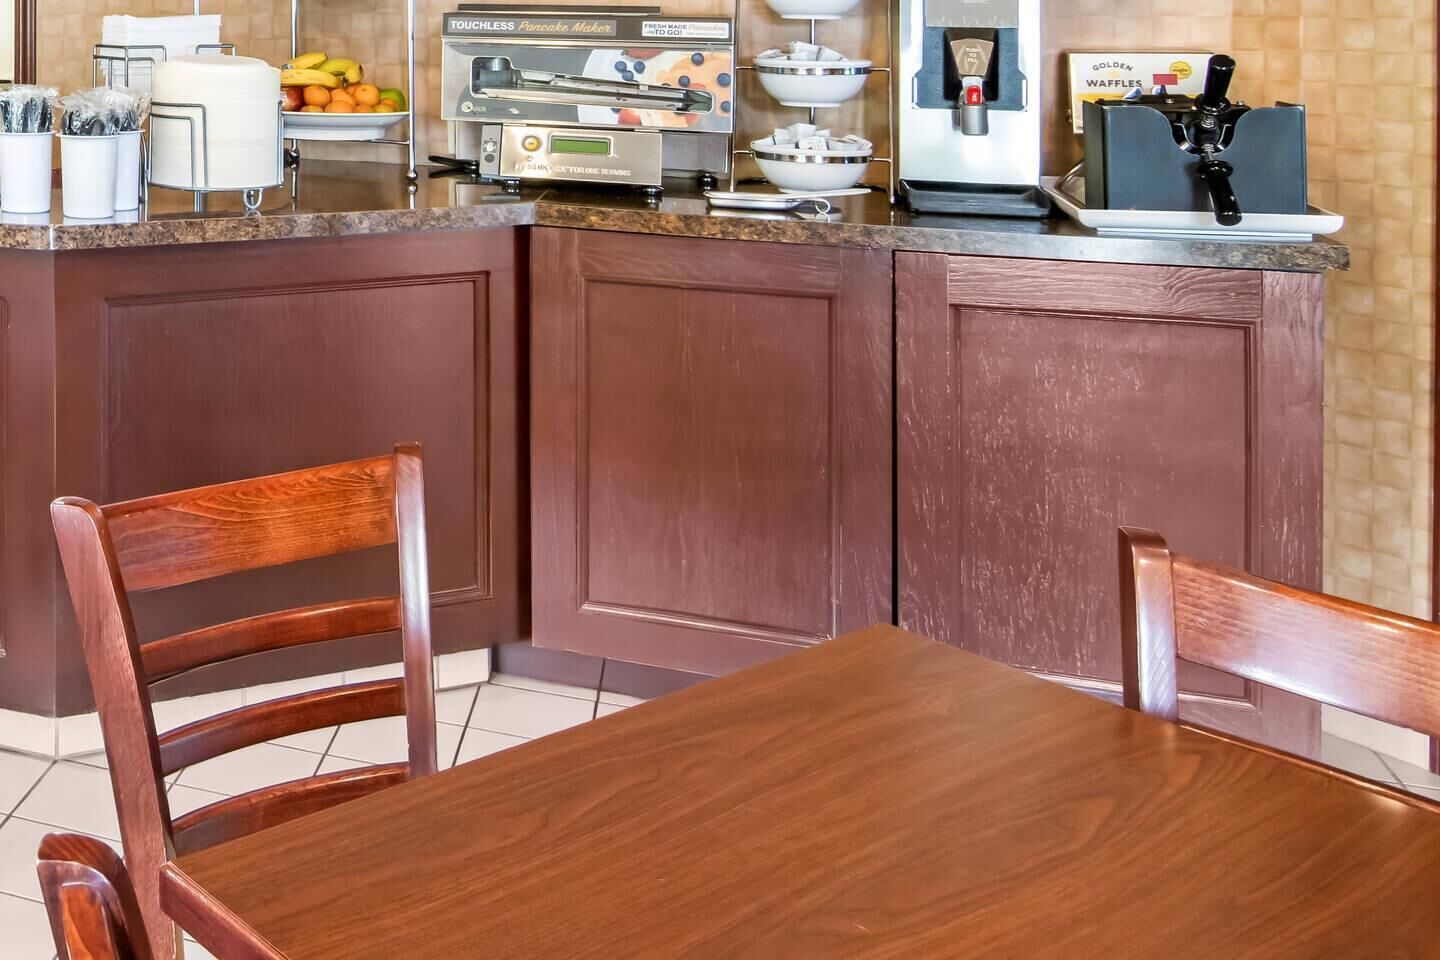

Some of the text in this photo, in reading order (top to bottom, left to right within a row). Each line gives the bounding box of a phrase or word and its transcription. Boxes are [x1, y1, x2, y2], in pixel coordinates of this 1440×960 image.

[450, 20, 612, 33] TOUCHLESS Pancake Maker
[1092, 61, 1134, 72] GOLDEN
[1086, 79, 1143, 88] WAFFLES
